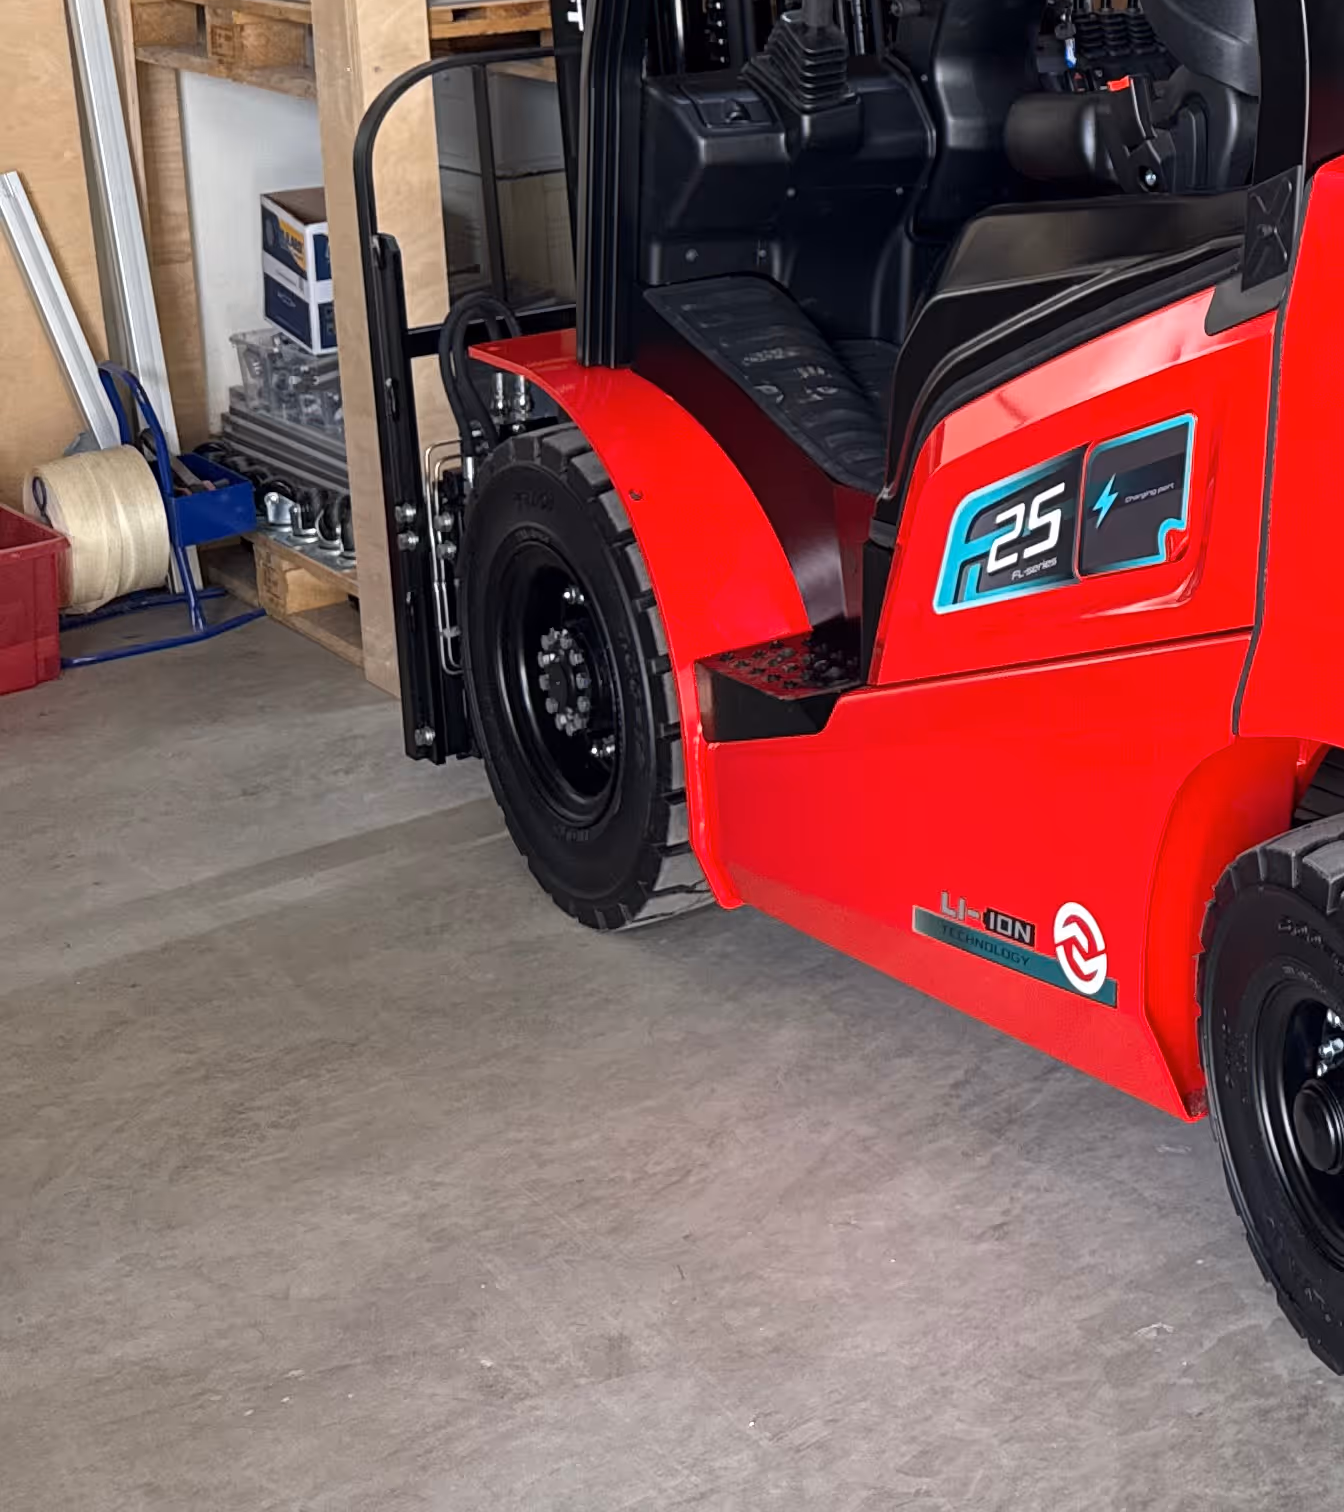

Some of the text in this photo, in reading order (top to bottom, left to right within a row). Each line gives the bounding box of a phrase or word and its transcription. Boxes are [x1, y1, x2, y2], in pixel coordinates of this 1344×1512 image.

[1124, 482, 1176, 504] Charging port
[1011, 556, 1058, 582] FL-series
[941, 924, 1031, 967] TECHNOLOGY
